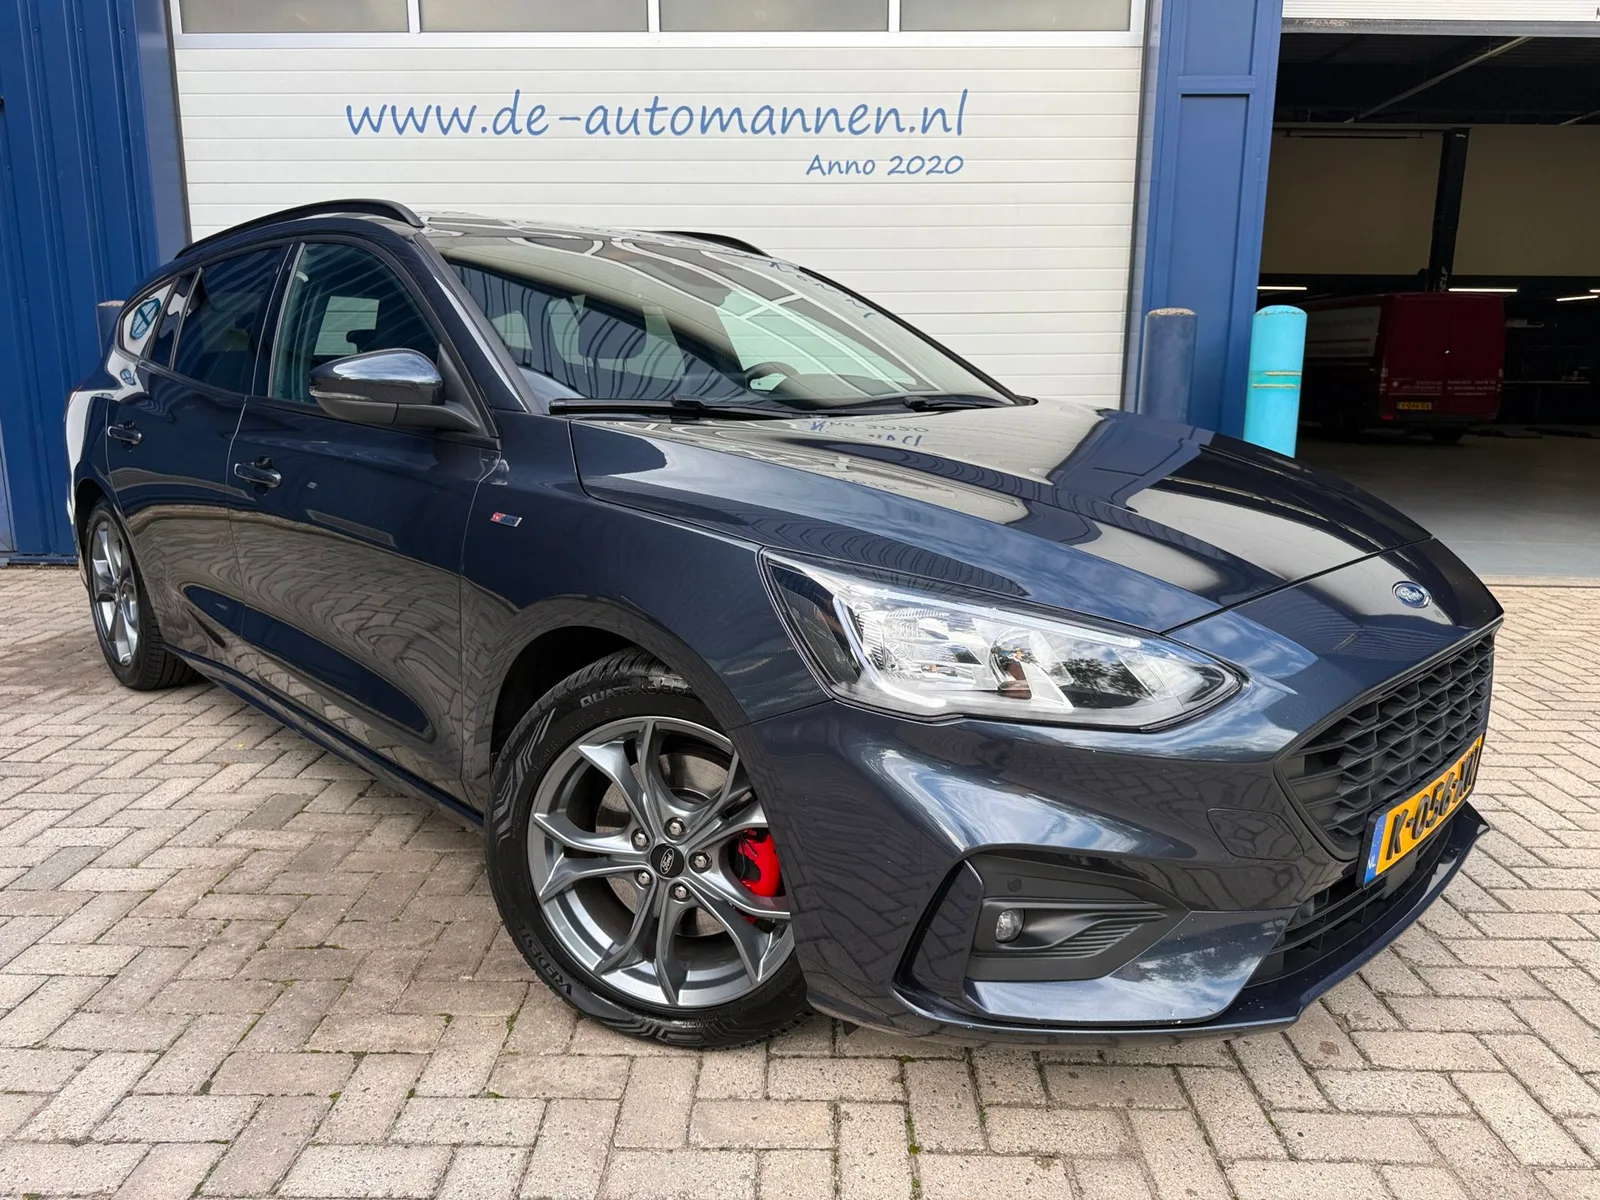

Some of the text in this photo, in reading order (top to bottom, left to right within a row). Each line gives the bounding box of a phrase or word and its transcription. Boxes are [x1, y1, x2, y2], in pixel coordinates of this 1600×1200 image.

[346, 89, 969, 137] www.de-automannen.nl
[806, 155, 964, 176] Anno 2020
[1439, 265, 1449, 293] OLF
